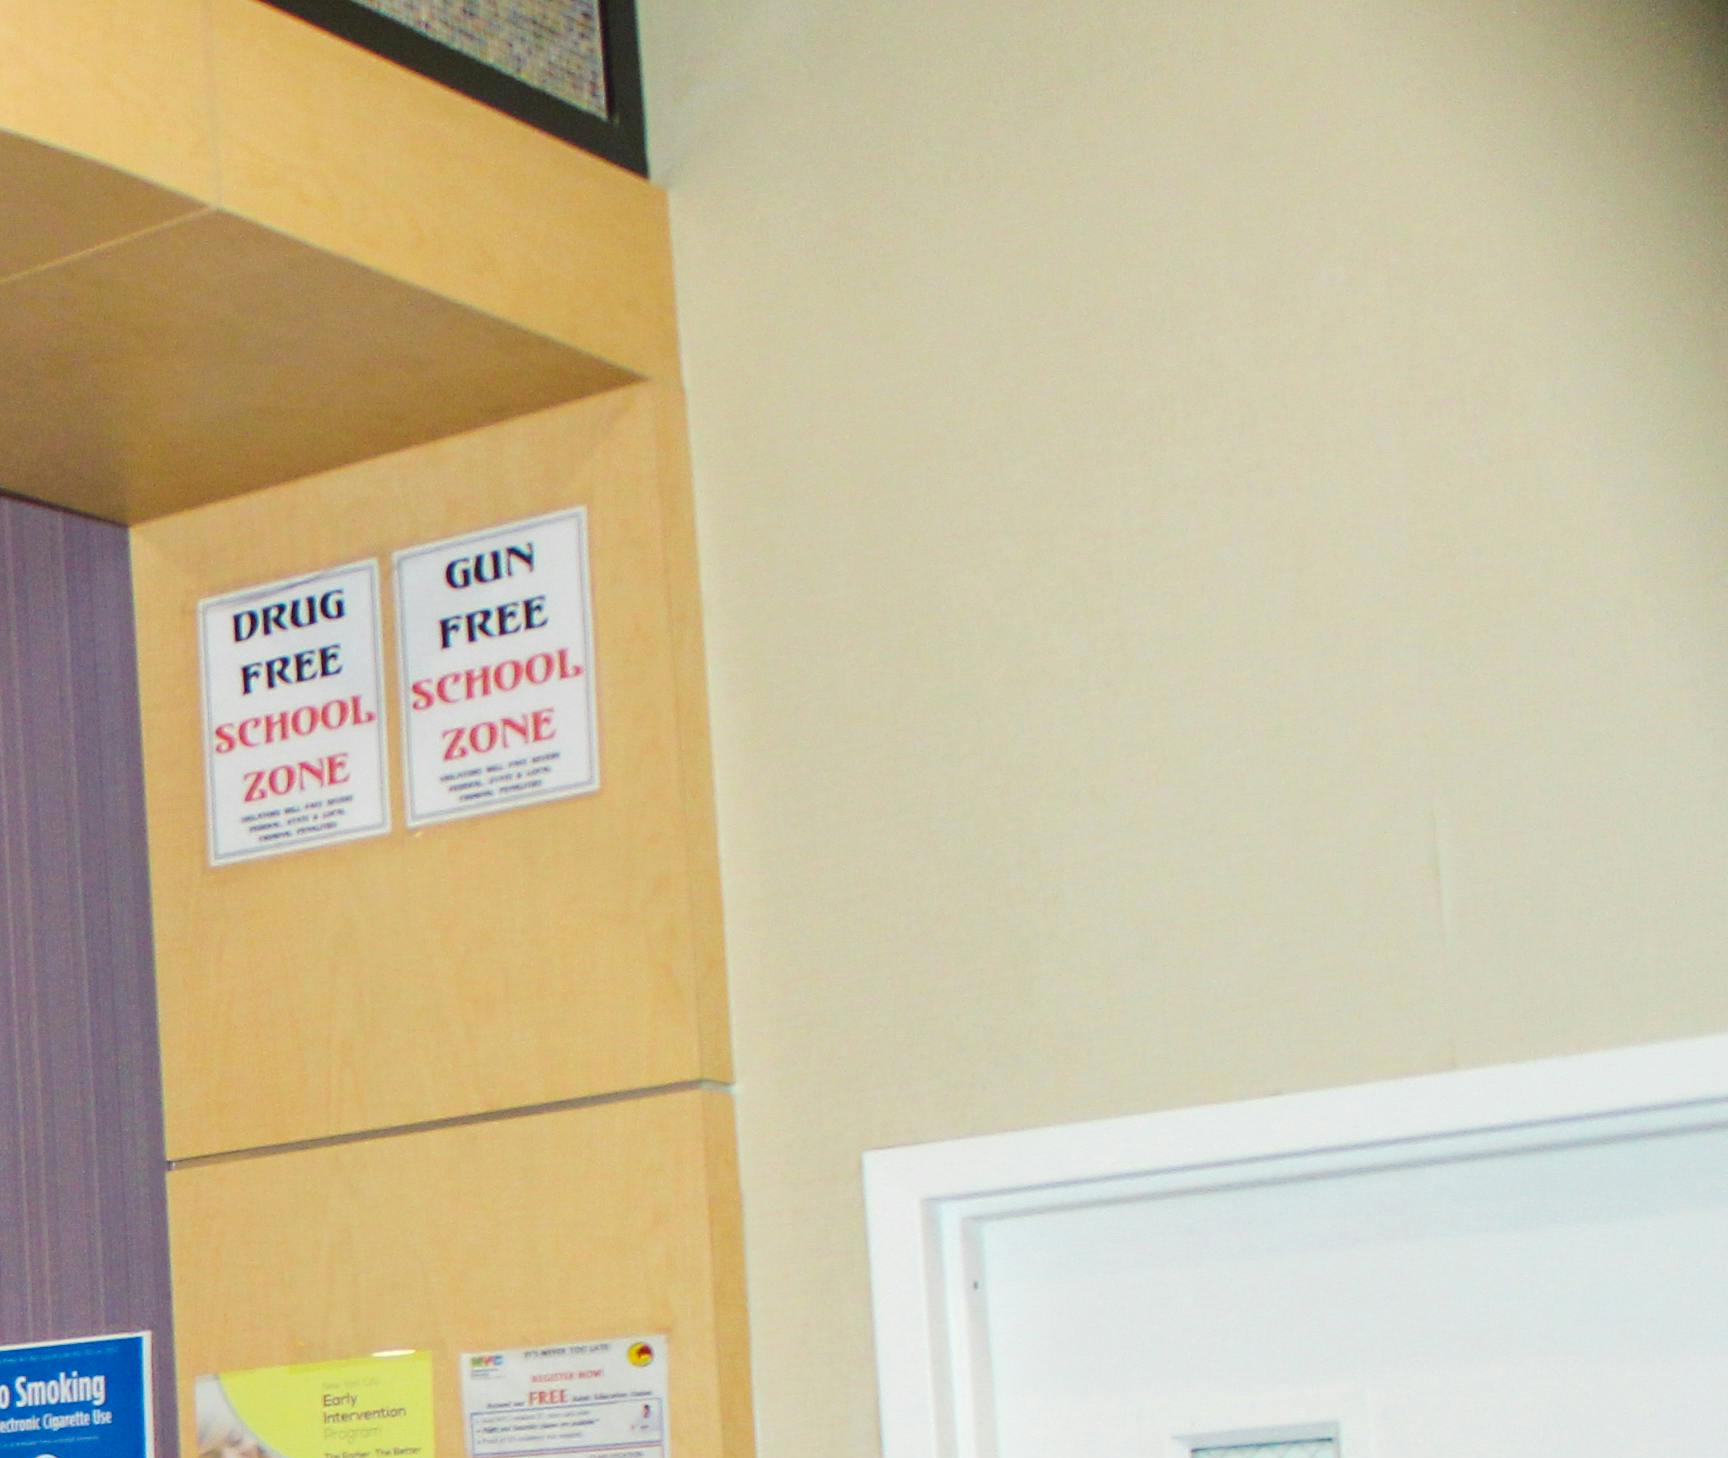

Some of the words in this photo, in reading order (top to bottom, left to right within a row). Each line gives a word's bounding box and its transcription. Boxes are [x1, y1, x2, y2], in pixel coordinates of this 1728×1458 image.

[444, 541, 536, 590] GUN
[232, 588, 346, 642] DRUG
[439, 595, 549, 650] FREE
[241, 643, 343, 695] FREE
[410, 647, 584, 712] SCHOOL
[215, 694, 376, 754] SCHOOL
[441, 707, 557, 761] ZONE
[243, 753, 350, 803] ZONE
[15, 1370, 106, 1406] Smoking
[322, 1393, 358, 1407] Early
[527, 1389, 567, 1405] FREE
[43, 1411, 90, 1432] Cigarette
[93, 1409, 112, 1425] Use
[323, 1407, 407, 1424] Intervention
